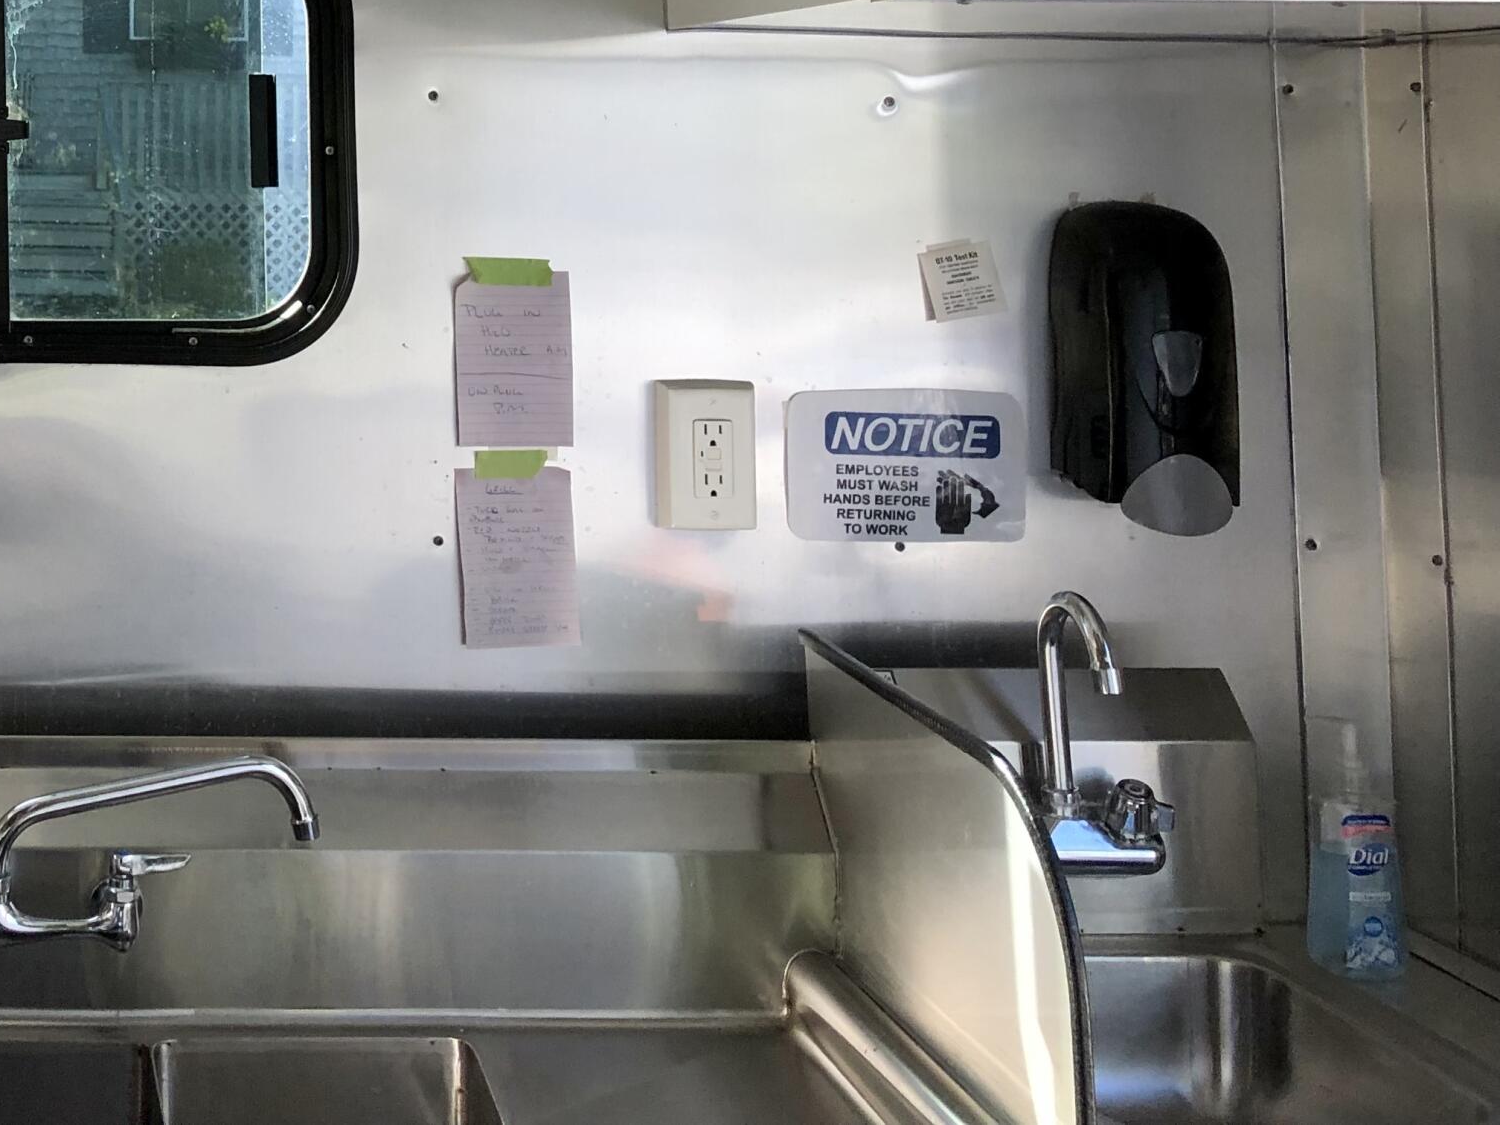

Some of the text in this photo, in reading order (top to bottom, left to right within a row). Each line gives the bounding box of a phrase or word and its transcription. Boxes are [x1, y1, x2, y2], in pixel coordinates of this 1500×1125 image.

[830, 416, 993, 454] NOTICE
[836, 463, 919, 477] EMPLOYEES
[836, 479, 918, 492] MUST WASH
[823, 493, 931, 507] HANDS BEFORE
[836, 508, 916, 521] RETURNING
[844, 523, 908, 535] TO WORK
[1349, 847, 1389, 865] Dial
